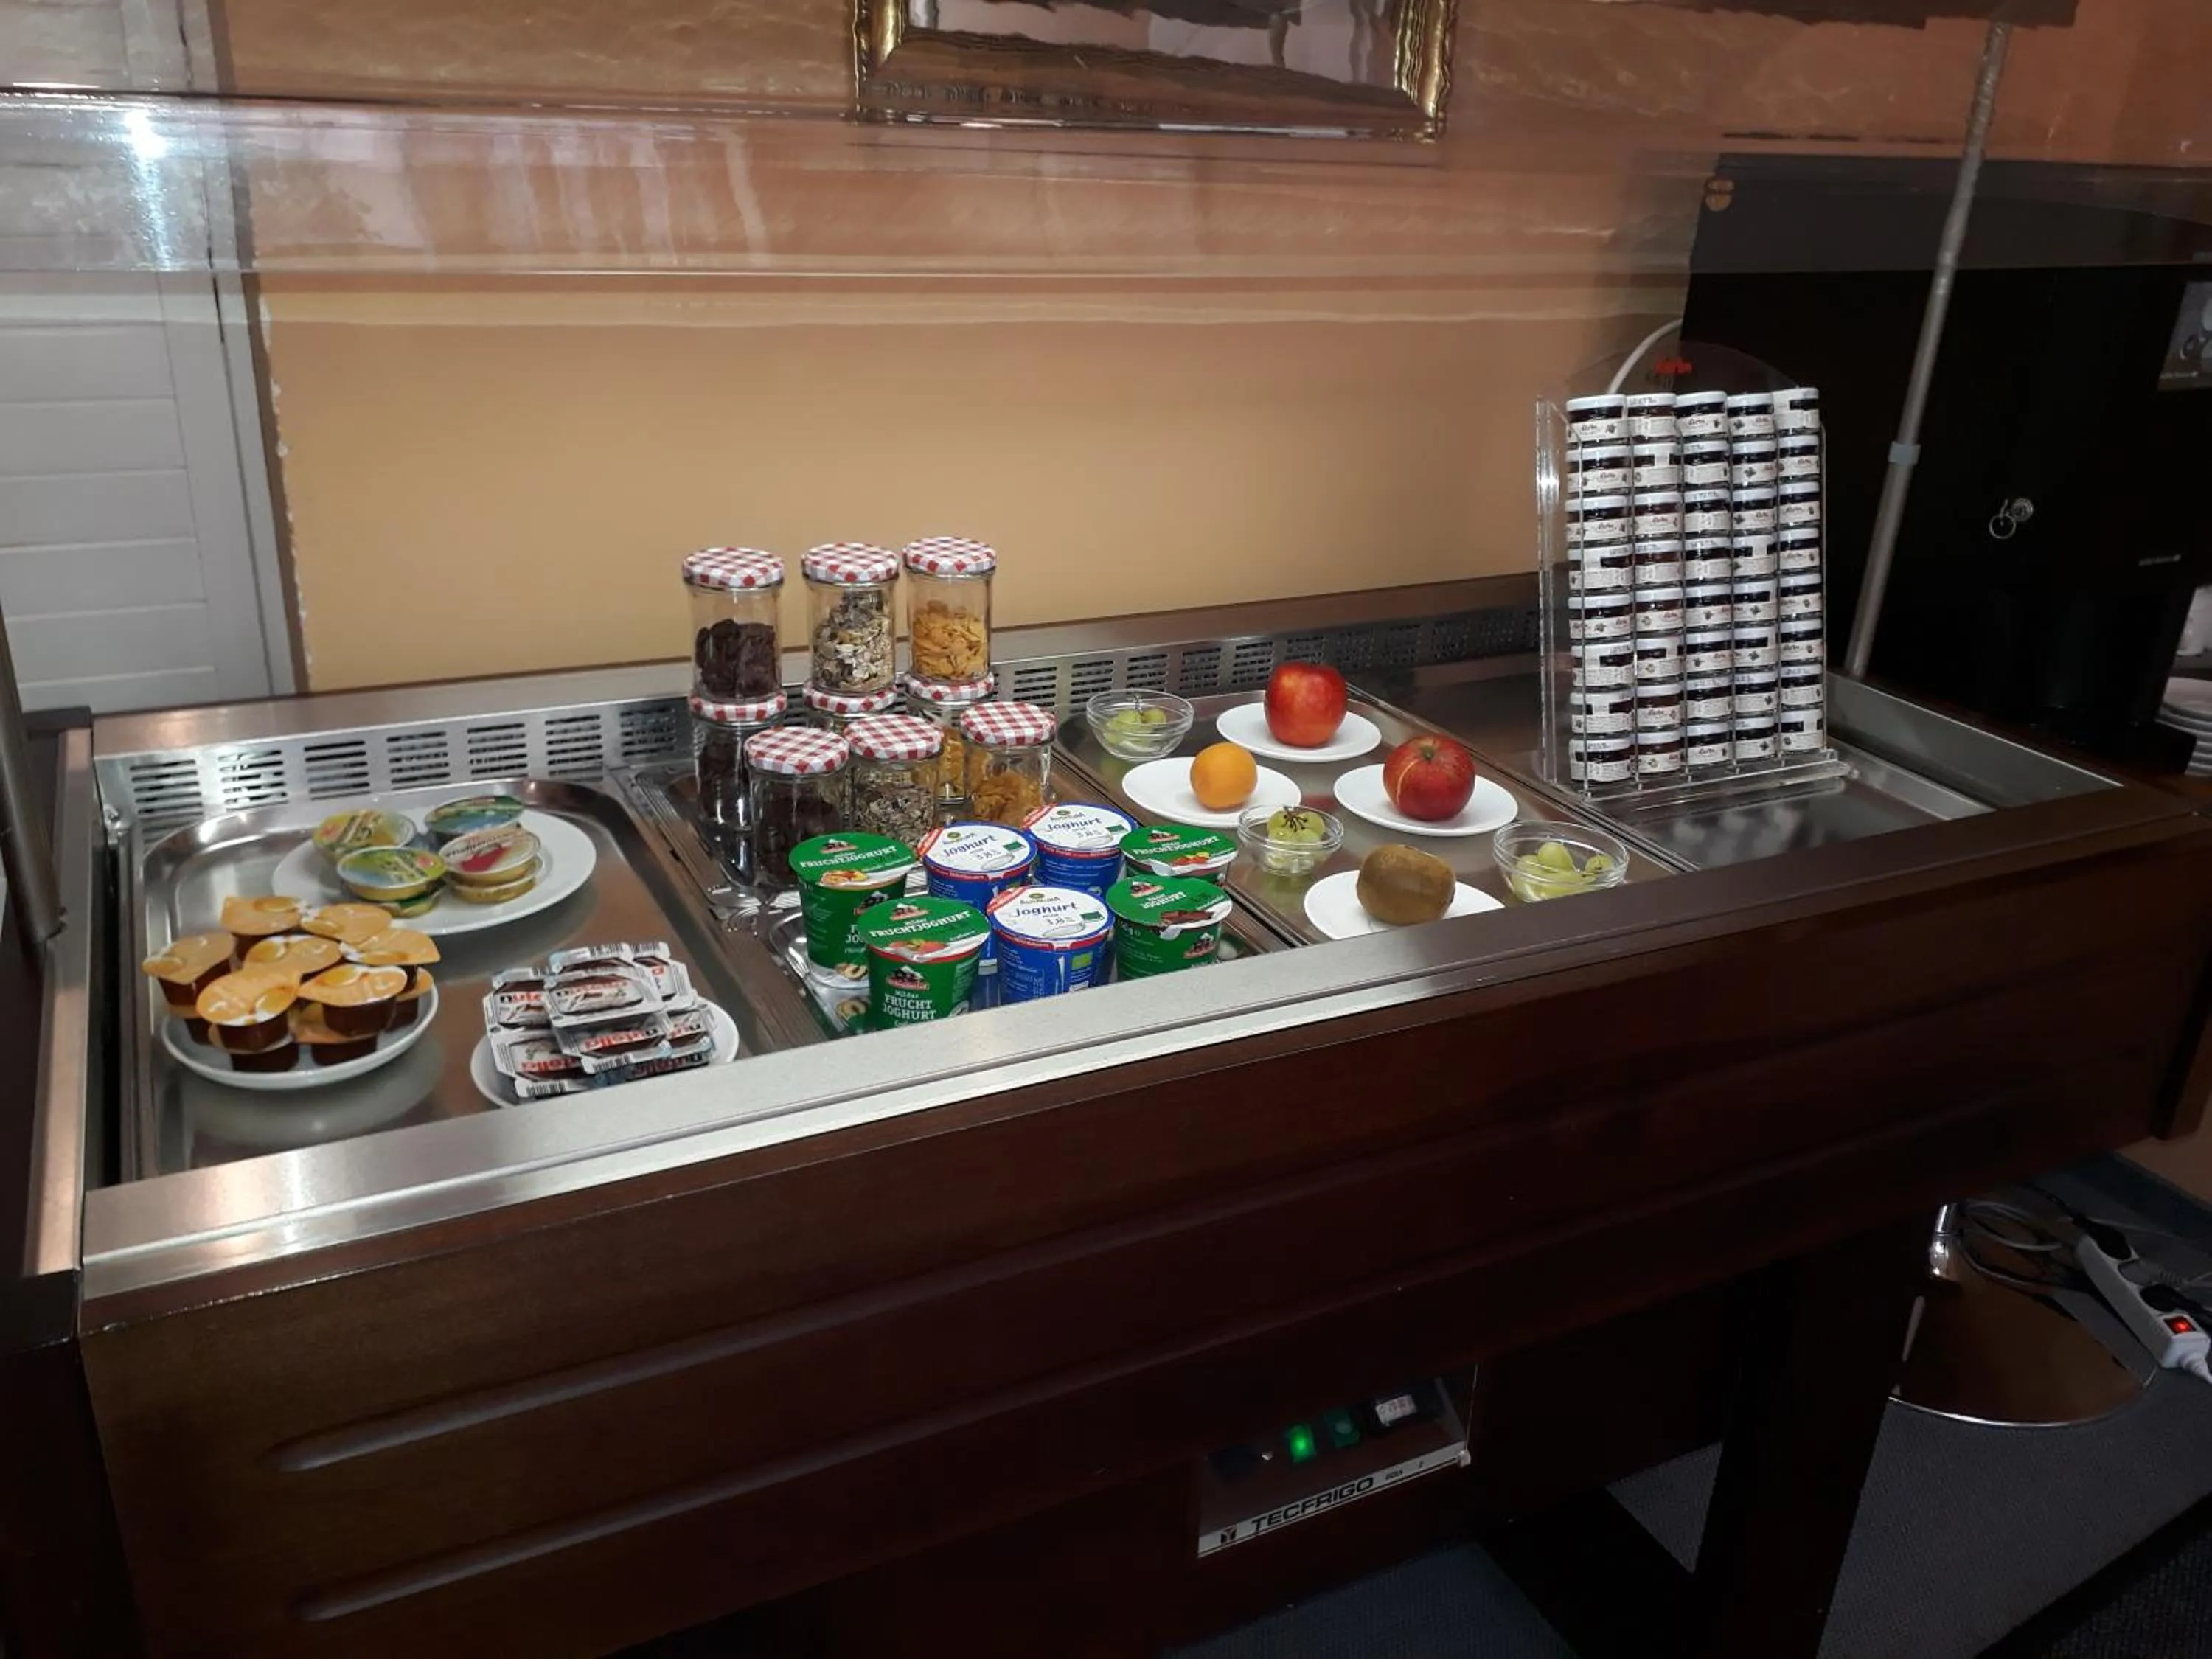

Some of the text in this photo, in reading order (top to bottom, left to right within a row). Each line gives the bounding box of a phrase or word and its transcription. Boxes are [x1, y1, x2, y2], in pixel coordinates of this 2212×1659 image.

[1046, 817, 1102, 832] Joghurt
[943, 833, 997, 858] Joghurt
[1014, 902, 1078, 918] Joghurt
[869, 911, 970, 937] FRUCHTJOGHURT
[885, 995, 933, 1009] FRUCHT
[883, 1004, 936, 1020] JOGHURT
[1251, 1477, 1374, 1533] TECFRIGO
